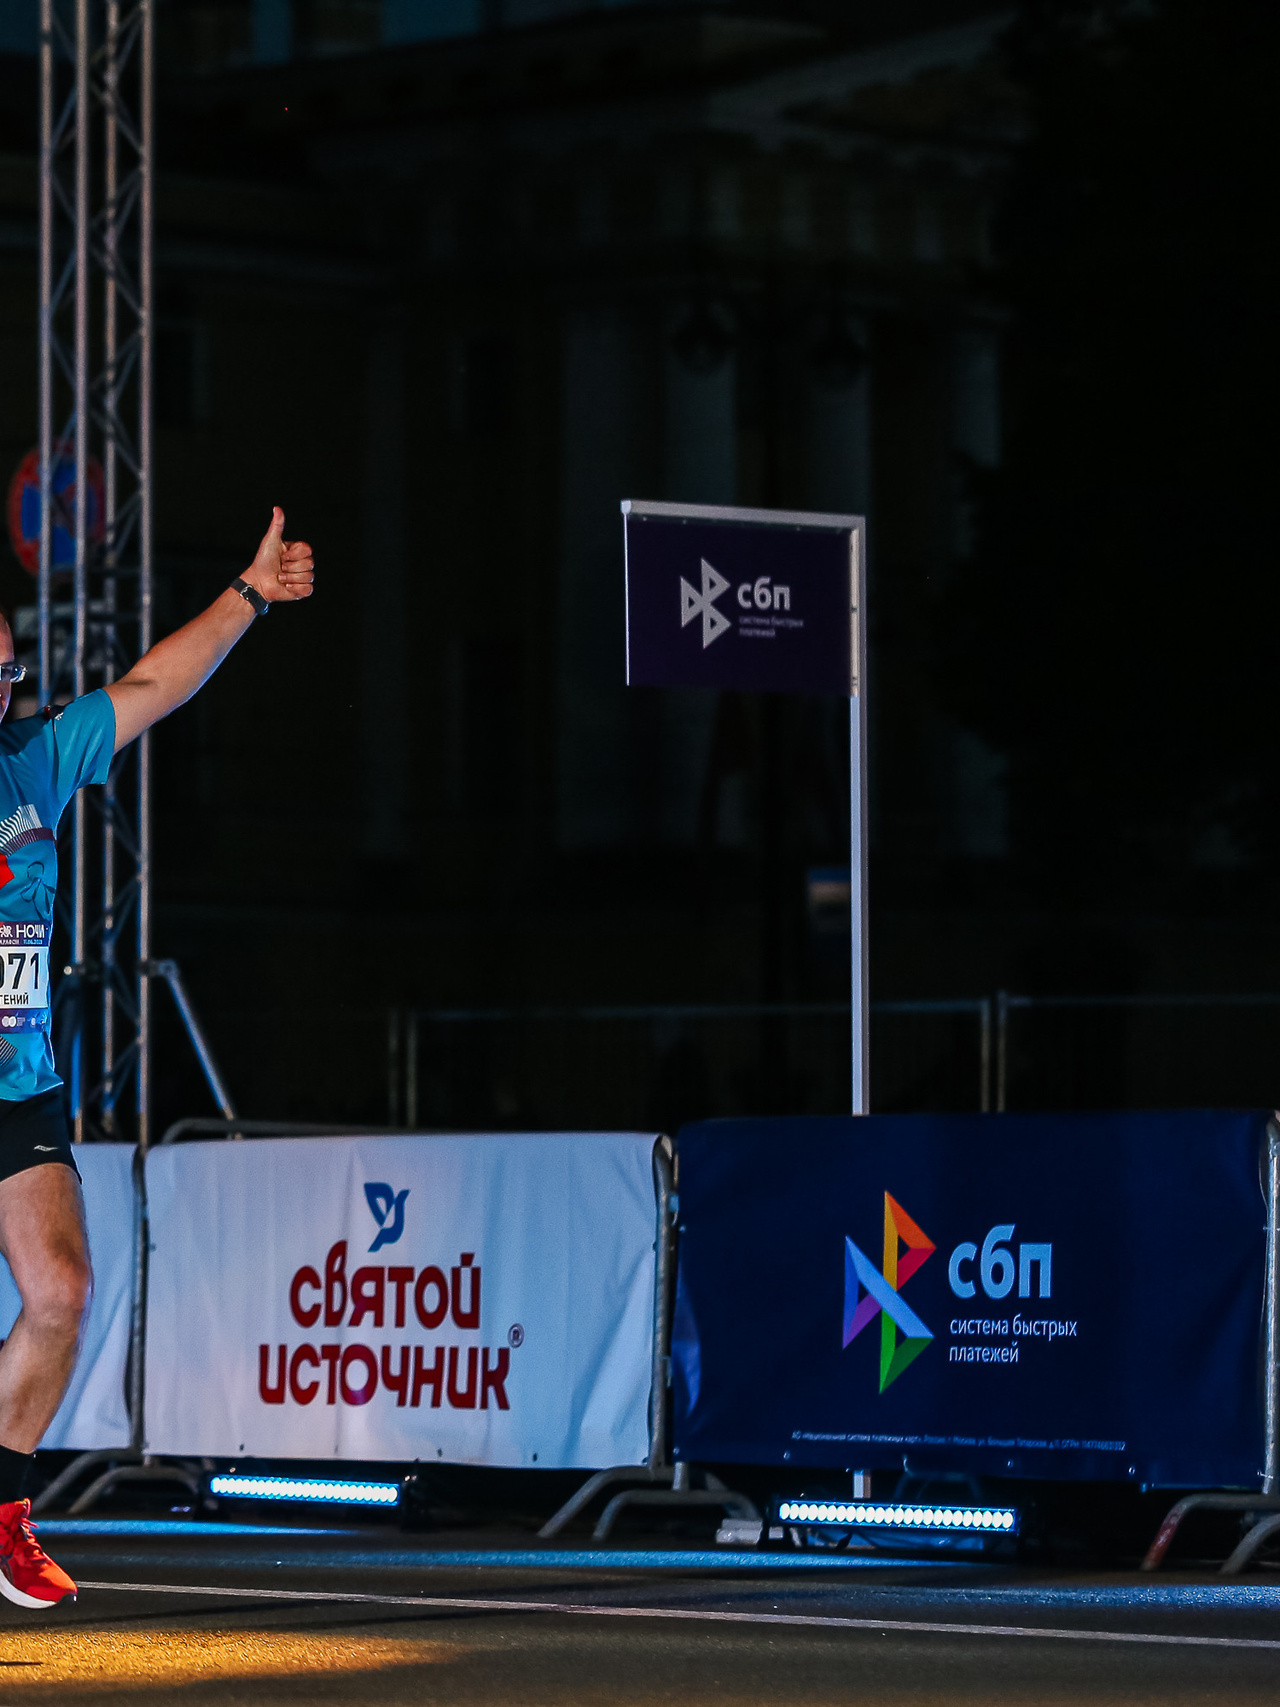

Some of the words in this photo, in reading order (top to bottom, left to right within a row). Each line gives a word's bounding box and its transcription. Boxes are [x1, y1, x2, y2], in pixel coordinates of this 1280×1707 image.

[737, 575, 791, 611] сбп
[15, 924, 45, 940] НОЧИ
[948, 1223, 1052, 1299] сбп
[949, 1318, 1009, 1335] система
[1012, 1312, 1078, 1342] быстрых
[949, 1340, 1019, 1363] платежей
